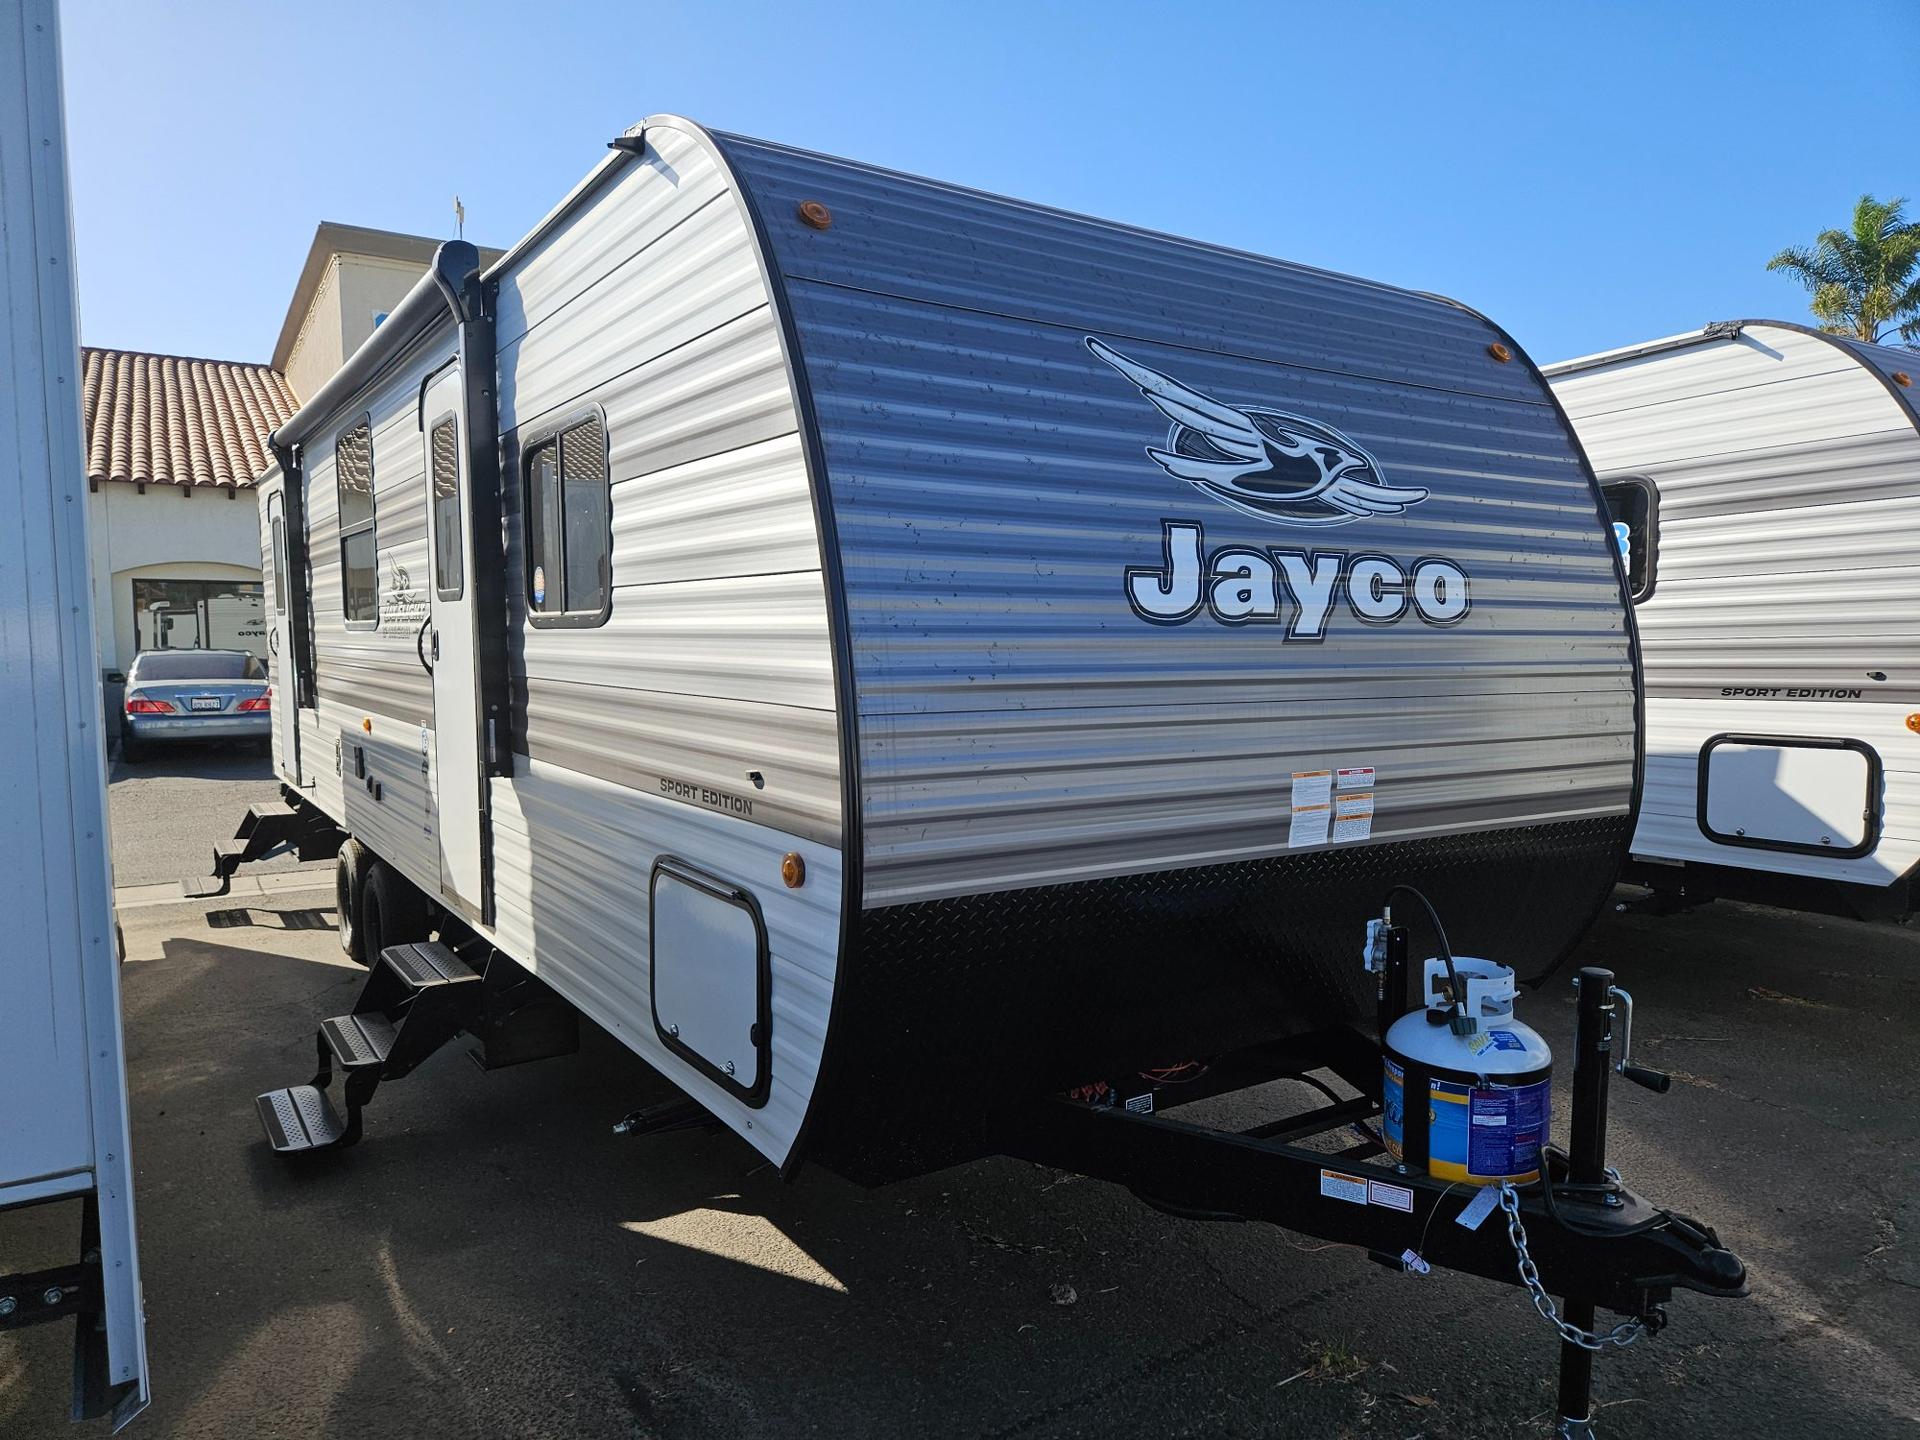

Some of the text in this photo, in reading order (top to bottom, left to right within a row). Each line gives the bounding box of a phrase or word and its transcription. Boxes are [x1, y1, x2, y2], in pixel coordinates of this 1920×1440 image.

[1125, 518, 1471, 645] Jayco
[1721, 687, 1862, 698] SPORT EDITION
[660, 778, 753, 815] SPORT EDITION
